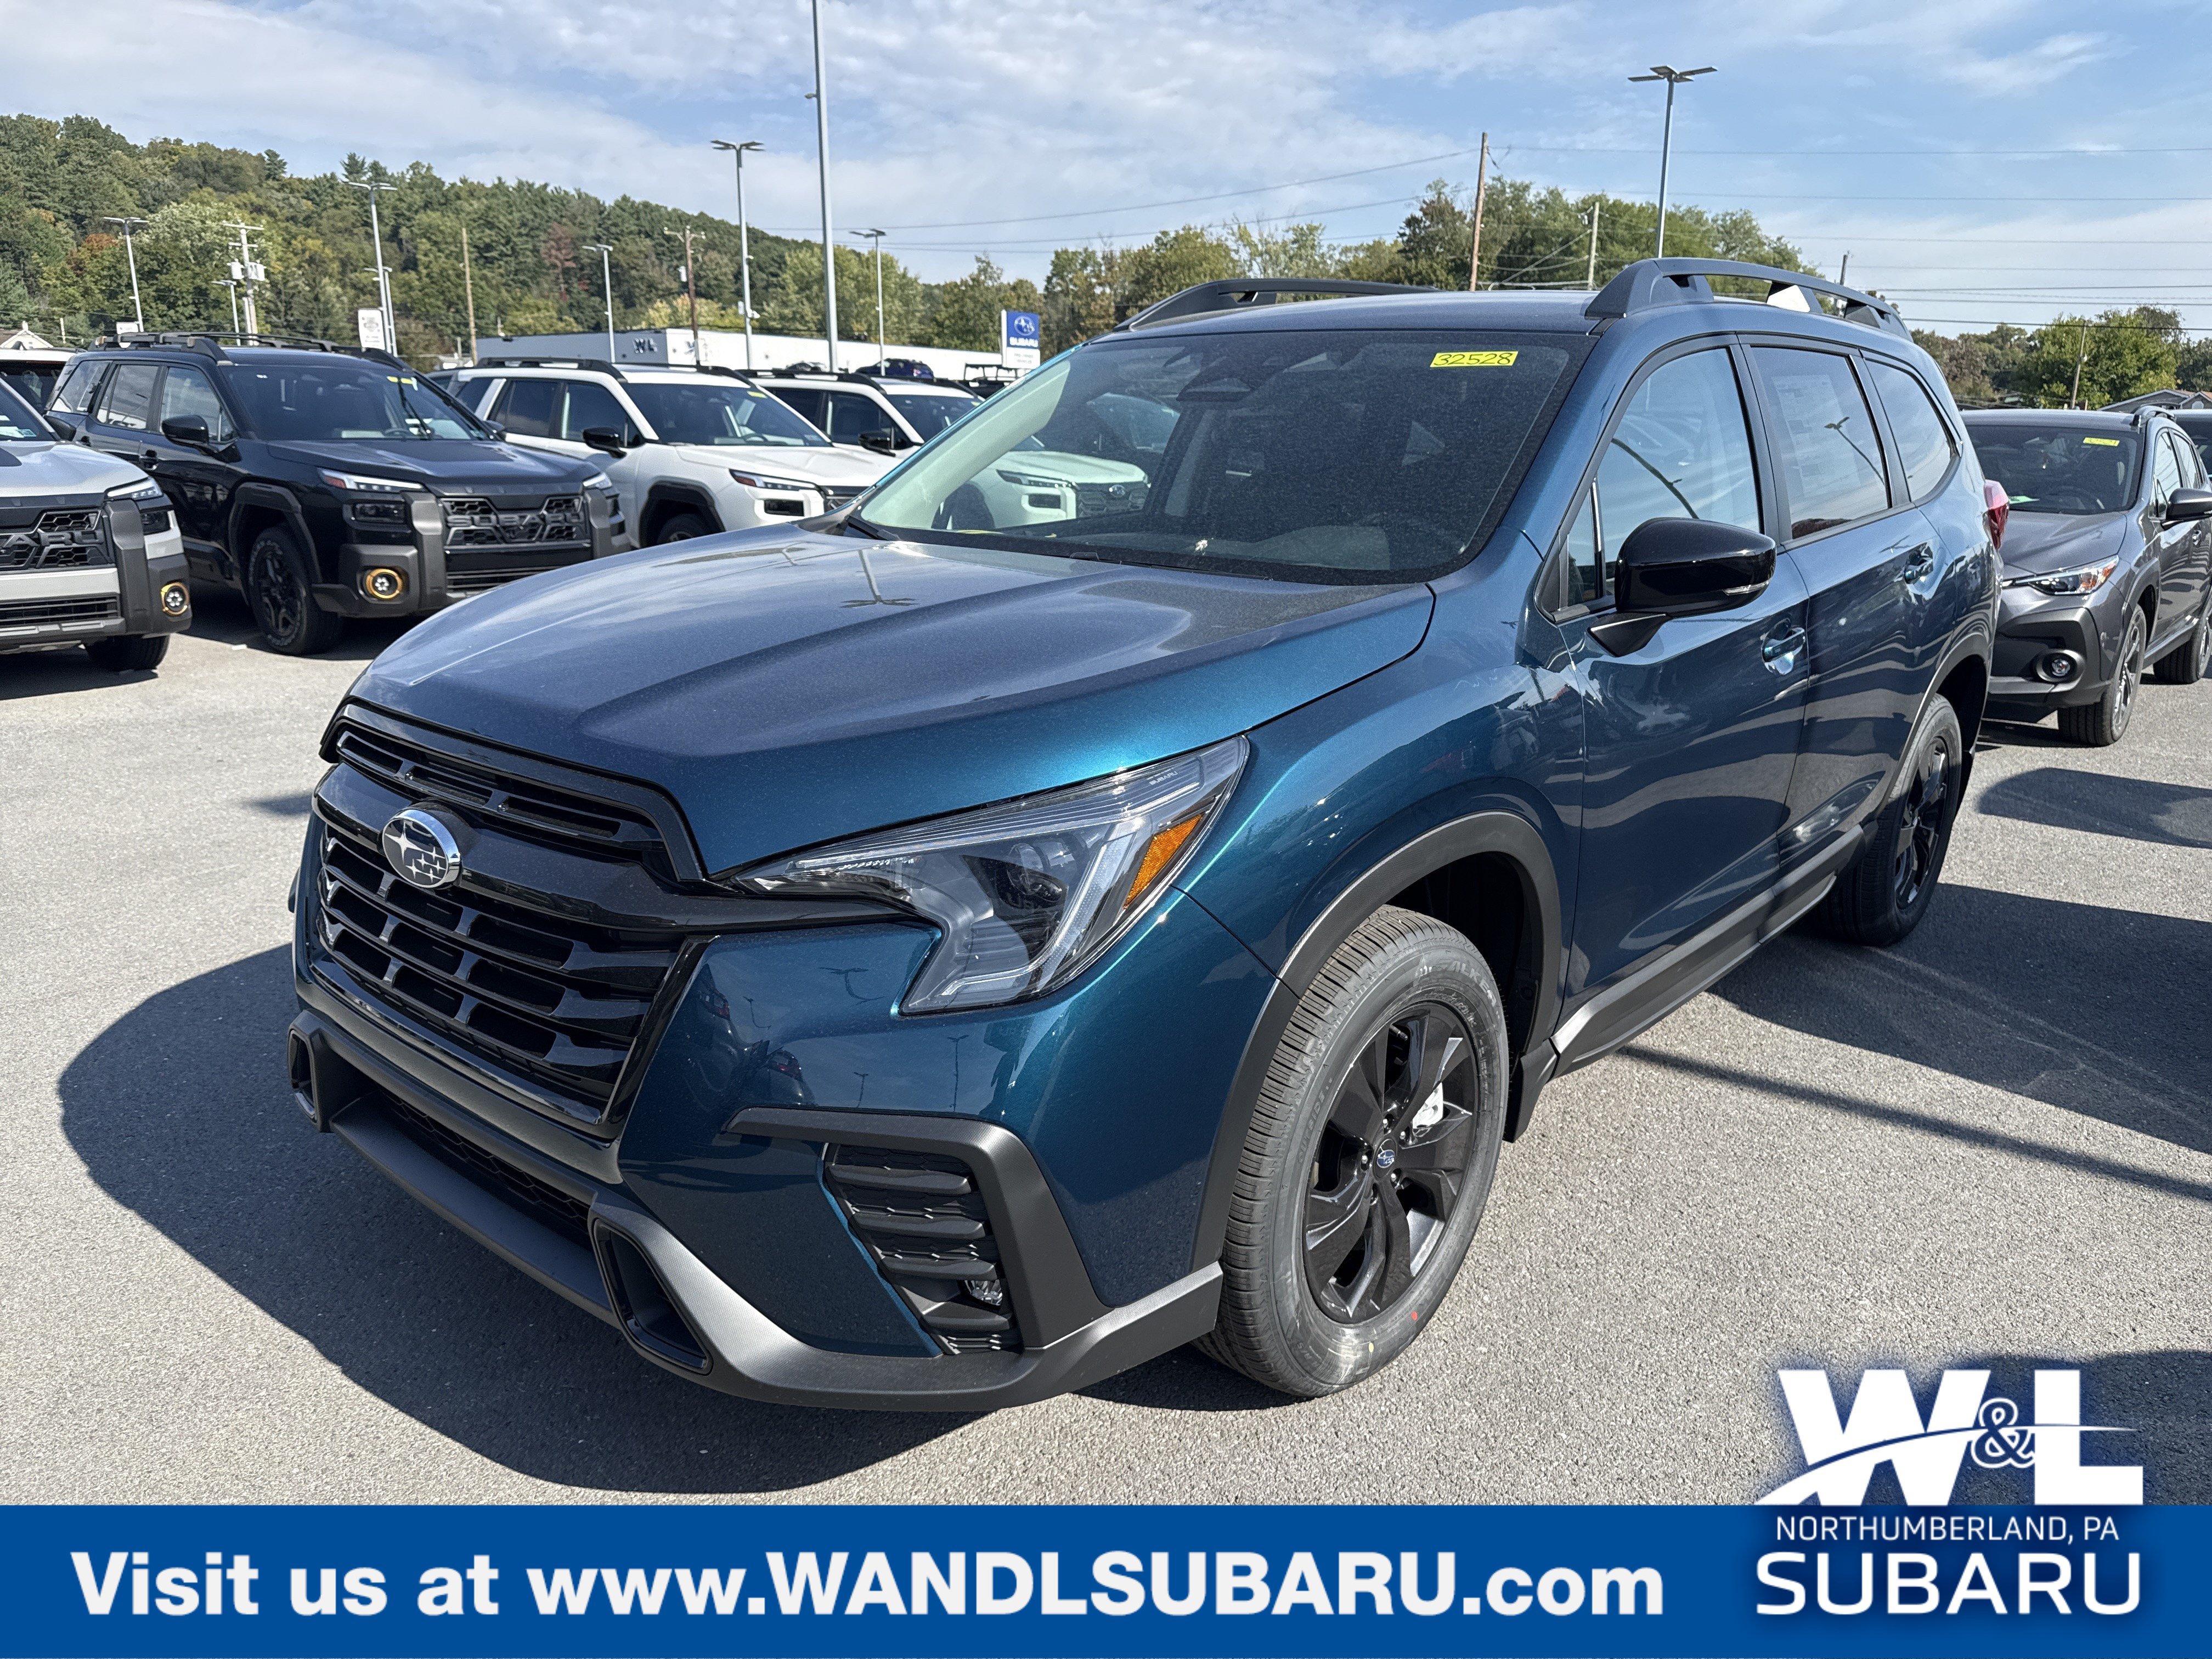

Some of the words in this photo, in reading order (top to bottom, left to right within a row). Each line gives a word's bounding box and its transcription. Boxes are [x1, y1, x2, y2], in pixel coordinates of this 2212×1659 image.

[1433, 352, 1514, 366] 32528
[447, 512, 585, 527] SUBARU
[1149, 771, 1178, 785] SUBARU
